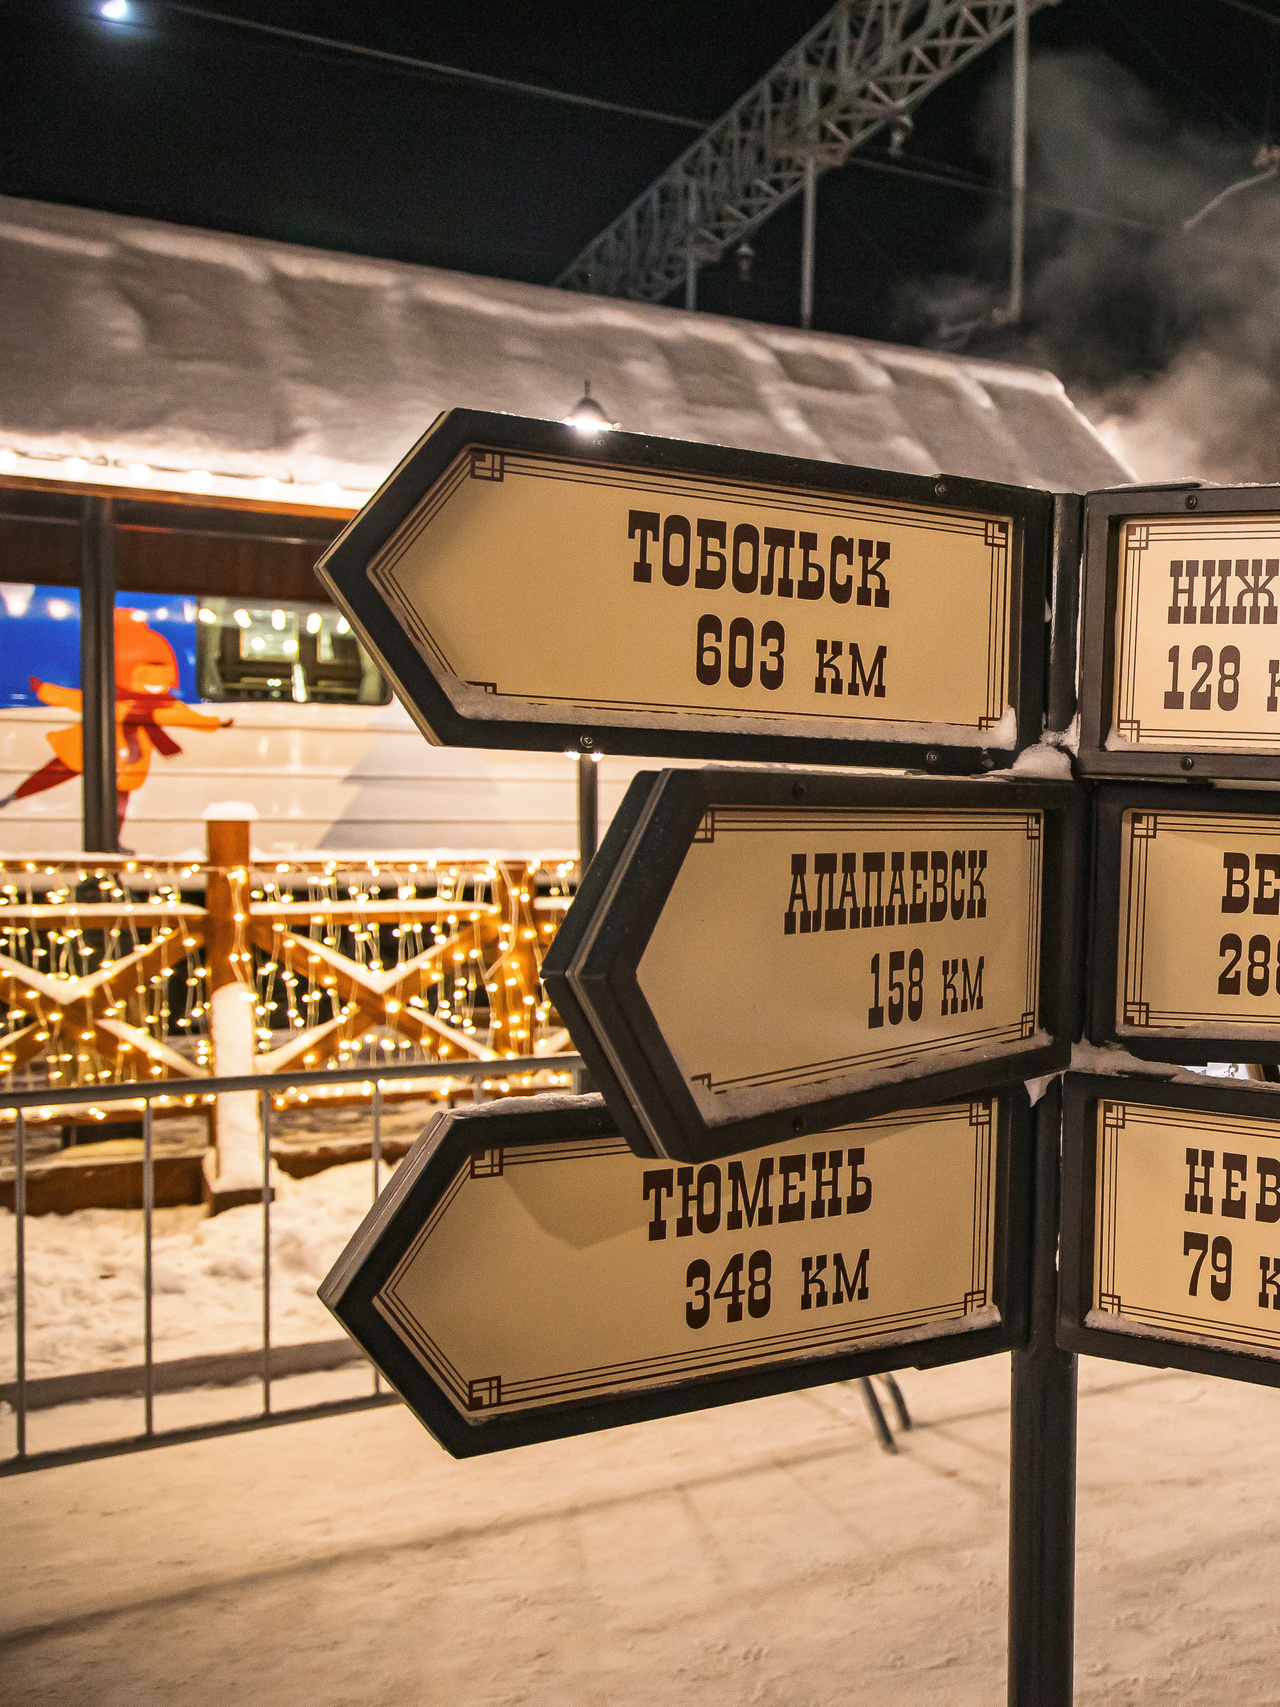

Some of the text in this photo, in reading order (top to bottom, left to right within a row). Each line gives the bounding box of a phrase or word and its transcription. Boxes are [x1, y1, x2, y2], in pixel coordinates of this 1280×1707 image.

[628, 509, 890, 608] ТОБОЛЬСК
[696, 614, 785, 690] 603
[1164, 645, 1240, 711] 128
[784, 850, 988, 935] АЛАПАЕВСК
[868, 949, 924, 1029] 158
[642, 1148, 873, 1241] ТЮМЕНЬ
[686, 1249, 771, 1330] 348
[1183, 1231, 1233, 1302] 79
